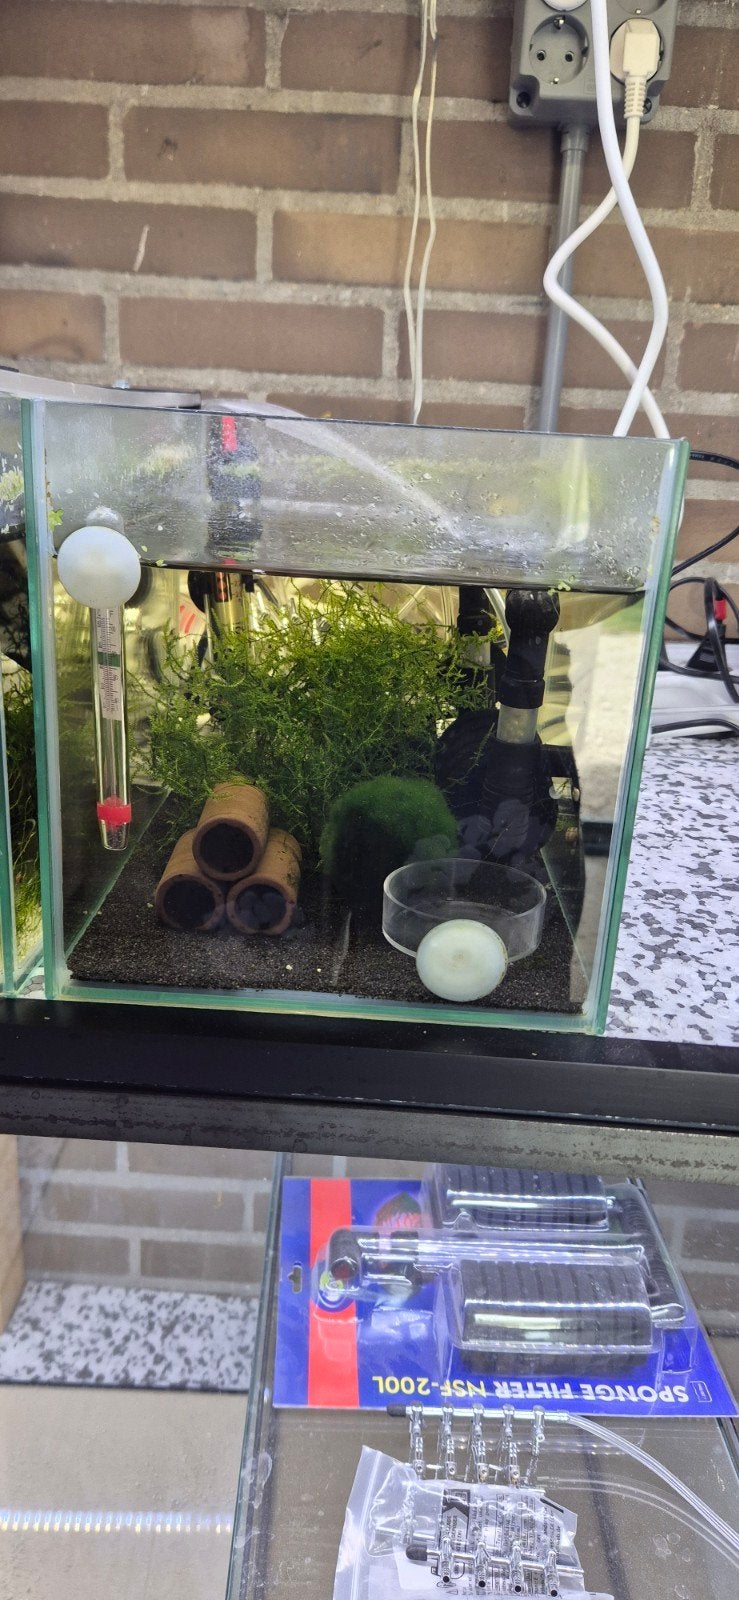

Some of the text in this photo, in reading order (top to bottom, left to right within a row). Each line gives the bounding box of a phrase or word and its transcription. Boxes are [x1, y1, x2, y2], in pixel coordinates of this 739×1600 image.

[372, 1375, 485, 1398] NSF-200L
[494, 1379, 570, 1400] FILTER
[582, 1383, 689, 1403] SPONGE
